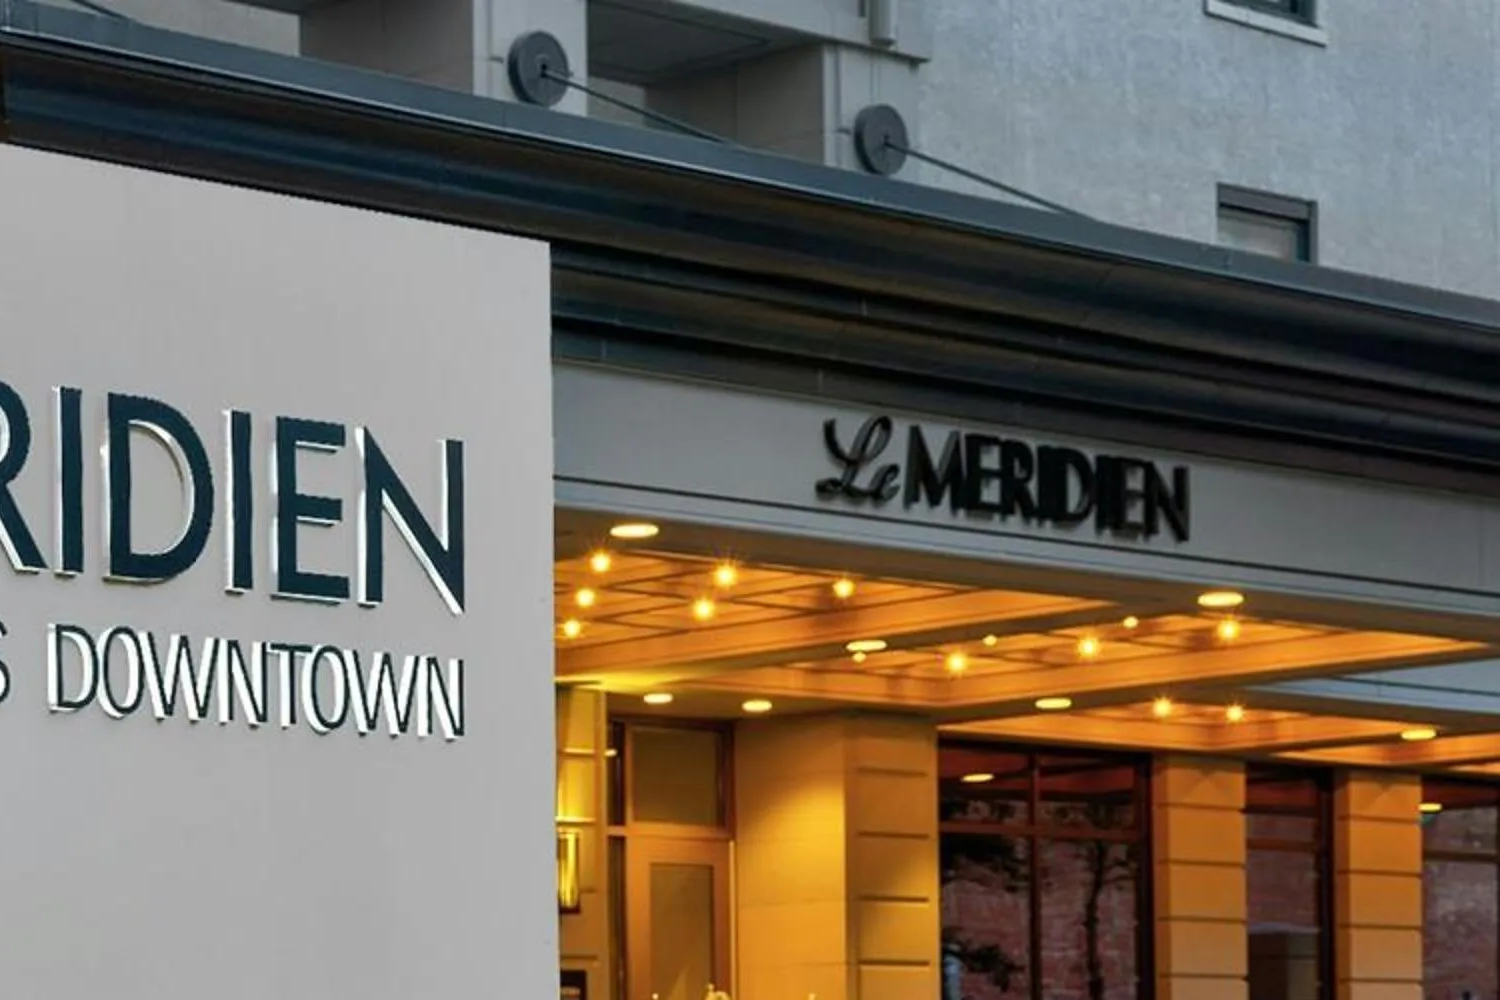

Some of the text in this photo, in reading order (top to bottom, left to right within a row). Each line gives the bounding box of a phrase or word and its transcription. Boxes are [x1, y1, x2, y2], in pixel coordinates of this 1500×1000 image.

[814, 414, 1190, 543] Le MERIDIEN
[47, 622, 465, 742] DOWNTOWN
